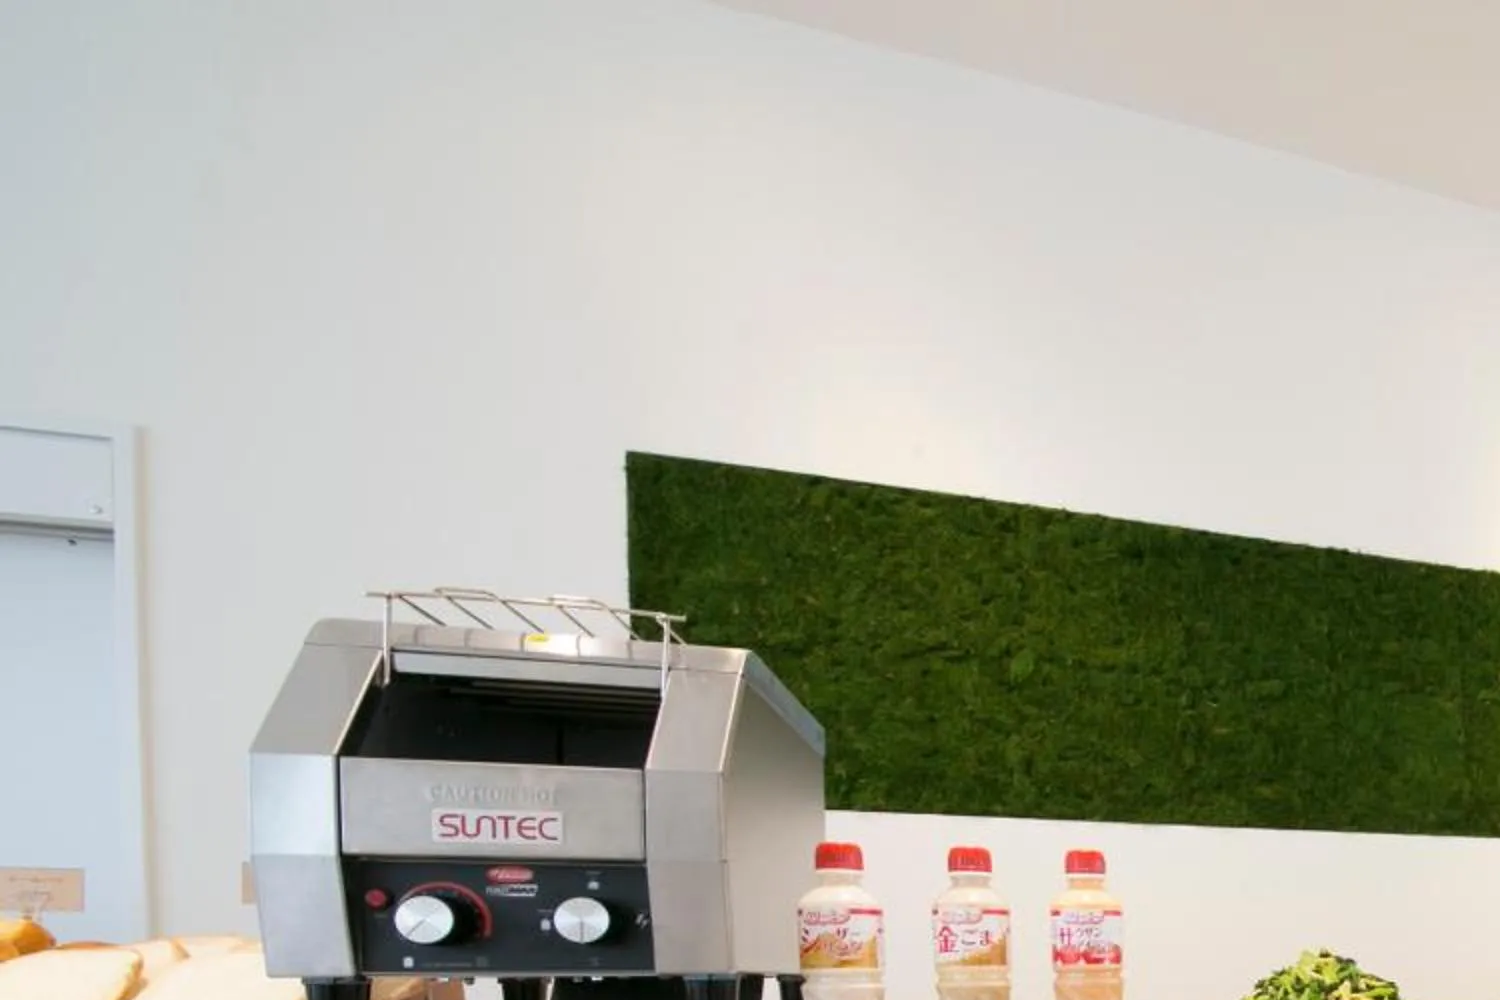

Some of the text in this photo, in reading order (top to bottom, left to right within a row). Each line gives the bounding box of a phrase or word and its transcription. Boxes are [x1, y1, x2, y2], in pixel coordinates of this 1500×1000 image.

[438, 813, 559, 841] SUNTEC
[938, 926, 990, 953] 金ごま
